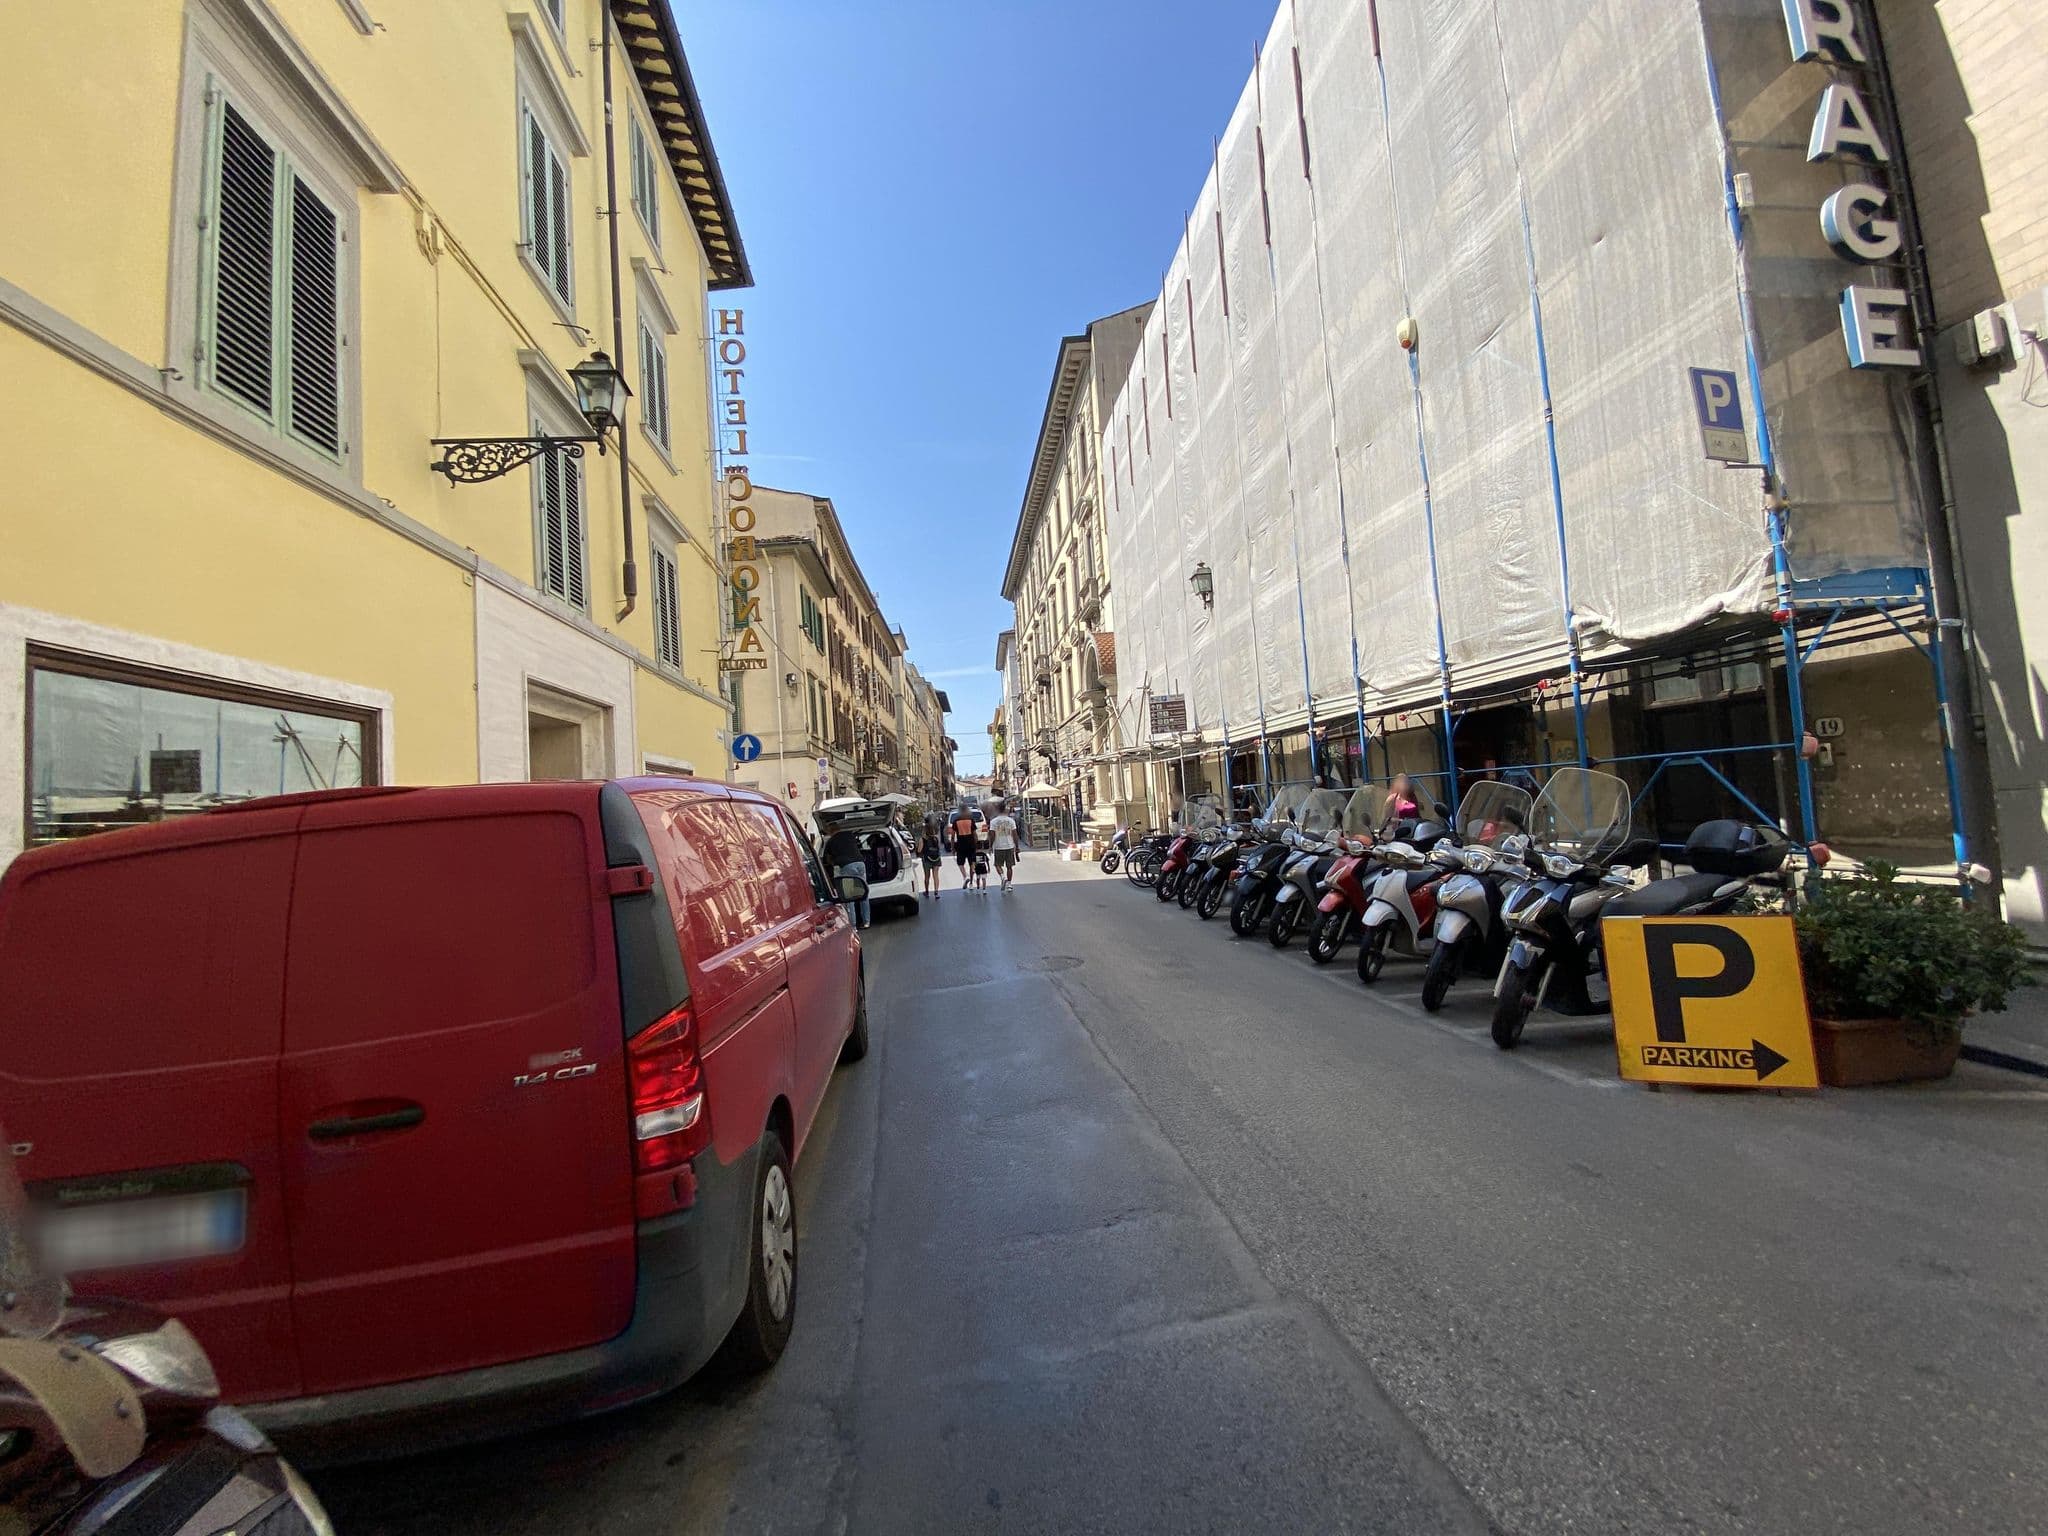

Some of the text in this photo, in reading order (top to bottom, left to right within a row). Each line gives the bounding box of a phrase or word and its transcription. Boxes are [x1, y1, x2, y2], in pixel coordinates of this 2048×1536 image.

[1701, 375, 1731, 422] P
[1821, 720, 1839, 735] 19
[1643, 924, 1755, 1043] P
[1643, 1048, 1754, 1068] PARKING
[554, 1063, 598, 1080] CDI
